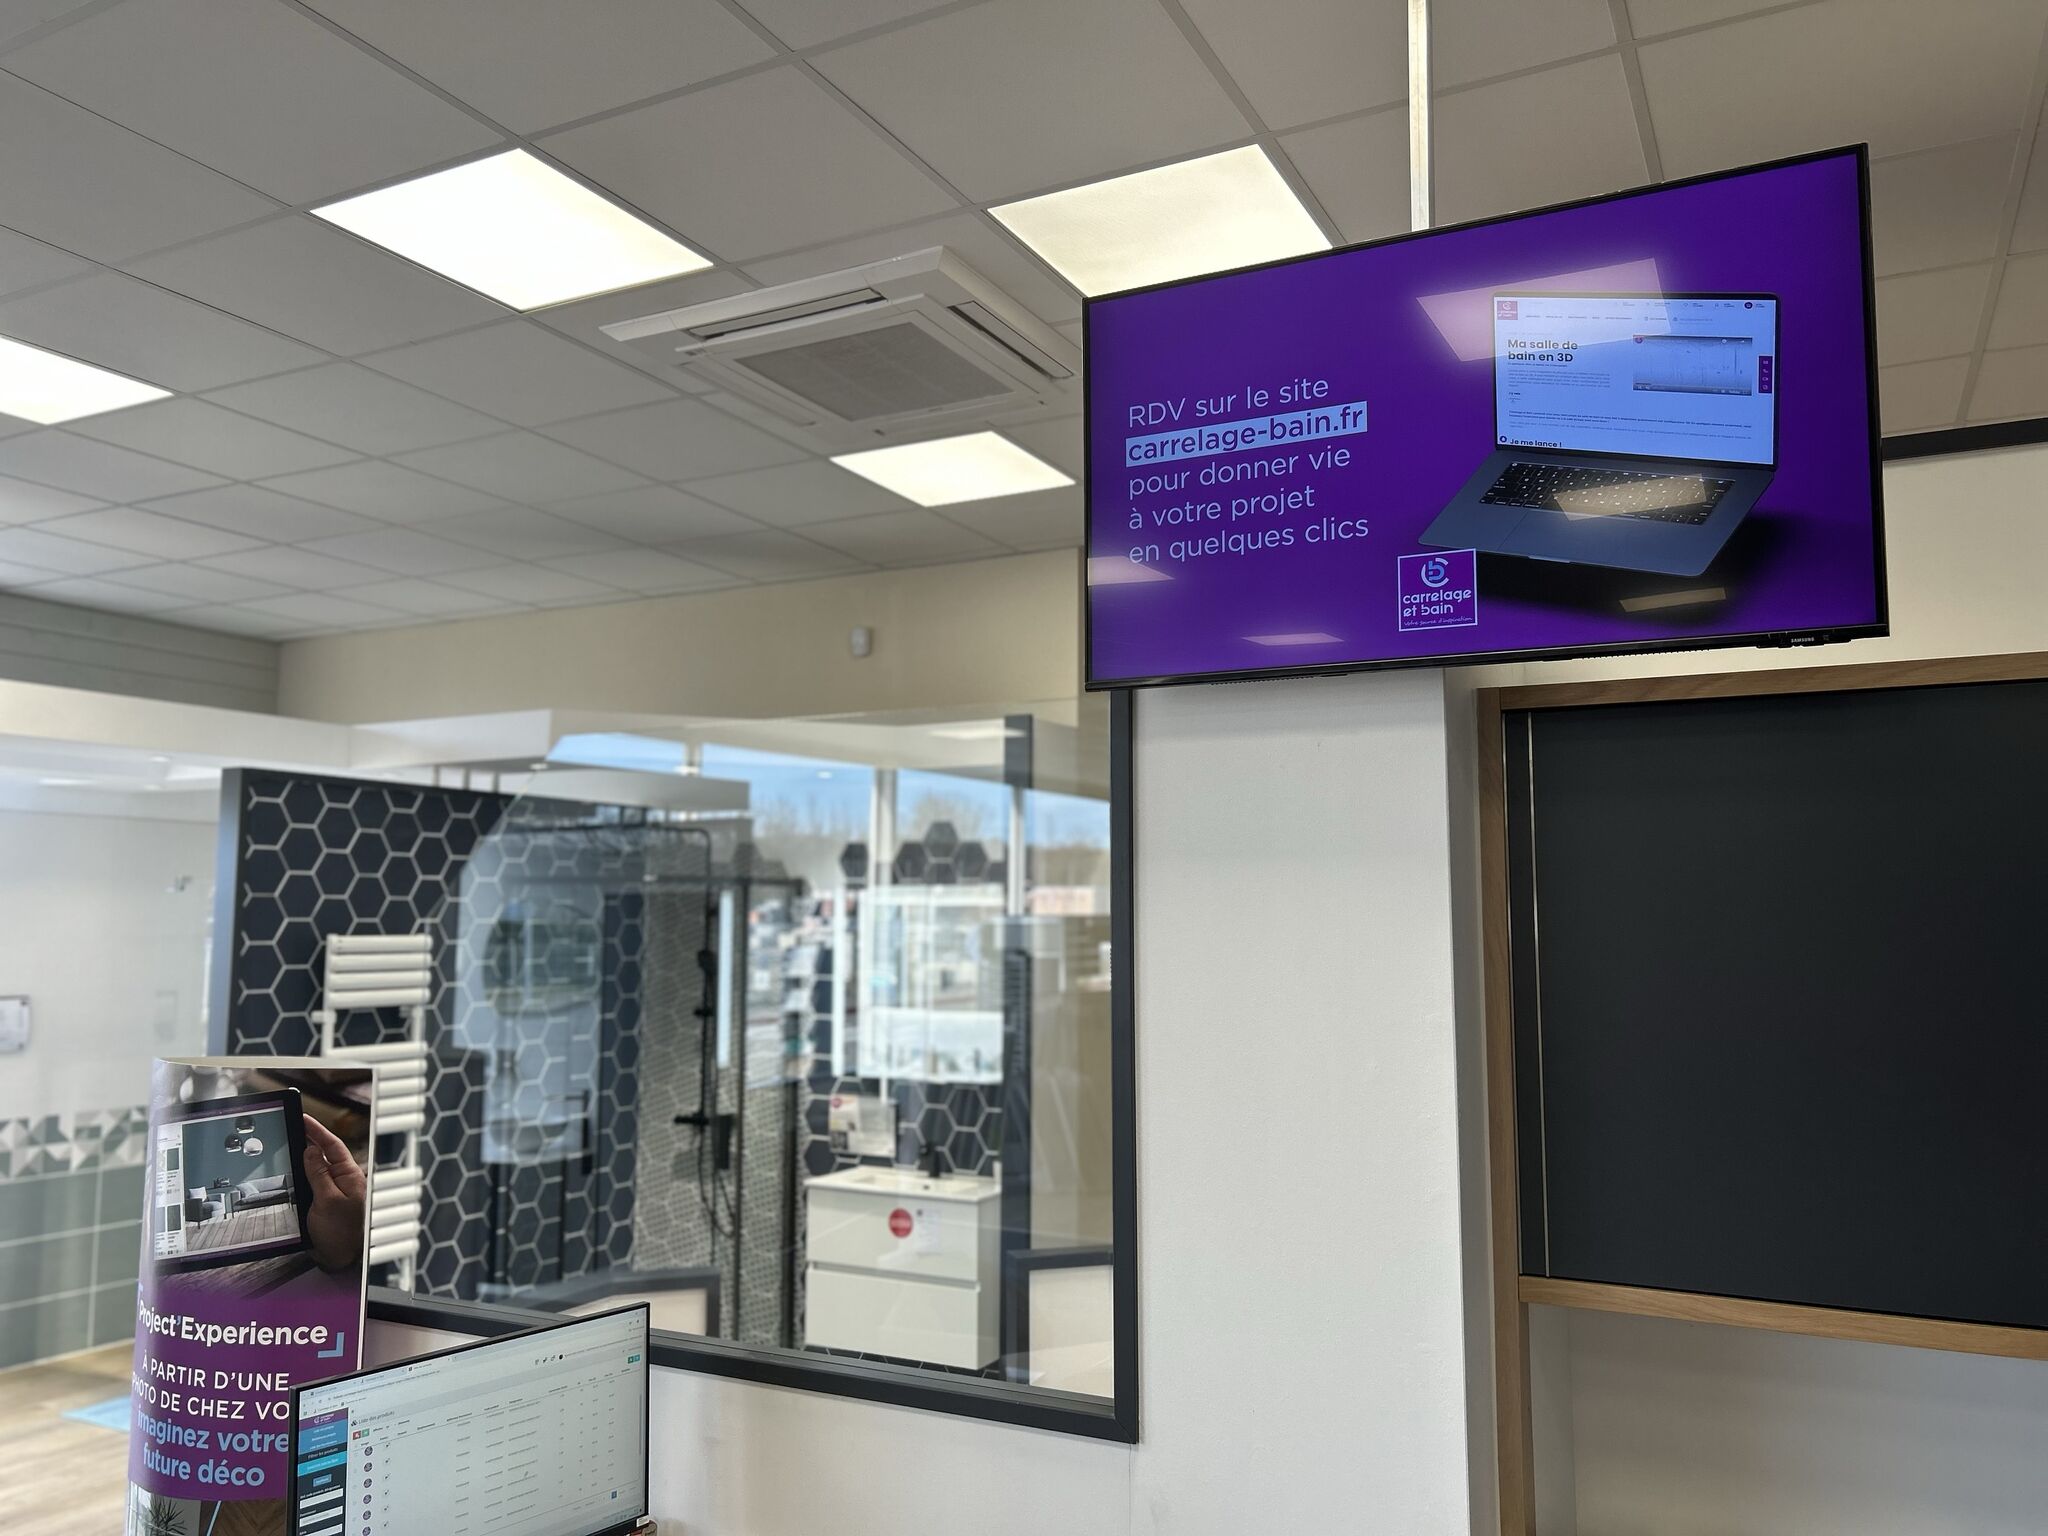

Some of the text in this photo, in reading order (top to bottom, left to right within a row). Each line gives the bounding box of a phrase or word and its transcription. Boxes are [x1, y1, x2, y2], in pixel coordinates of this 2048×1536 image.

[1507, 339, 1578, 350] Ma salle de
[1508, 351, 1573, 362] bain en 3D
[1129, 378, 1329, 427] RDV sur le site
[1128, 406, 1363, 461] carrelage-bain.fr
[1129, 445, 1351, 499] pour donner vie
[1128, 485, 1316, 529] à votre projet
[1129, 517, 1369, 564] en quelques clics
[1402, 589, 1472, 604] carrelage
[1403, 602, 1454, 617] et bain
[138, 1299, 329, 1347] Project'Experience
[131, 1370, 157, 1405] PHOTO
[160, 1389, 181, 1413] DE
[186, 1396, 245, 1420] CHEZ
[255, 1400, 290, 1420] VO
[150, 1357, 207, 1388] PARTIR
[213, 1370, 290, 1392] D'UNE
[137, 1403, 290, 1453] imaginez votre
[143, 1441, 266, 1487] future déco
